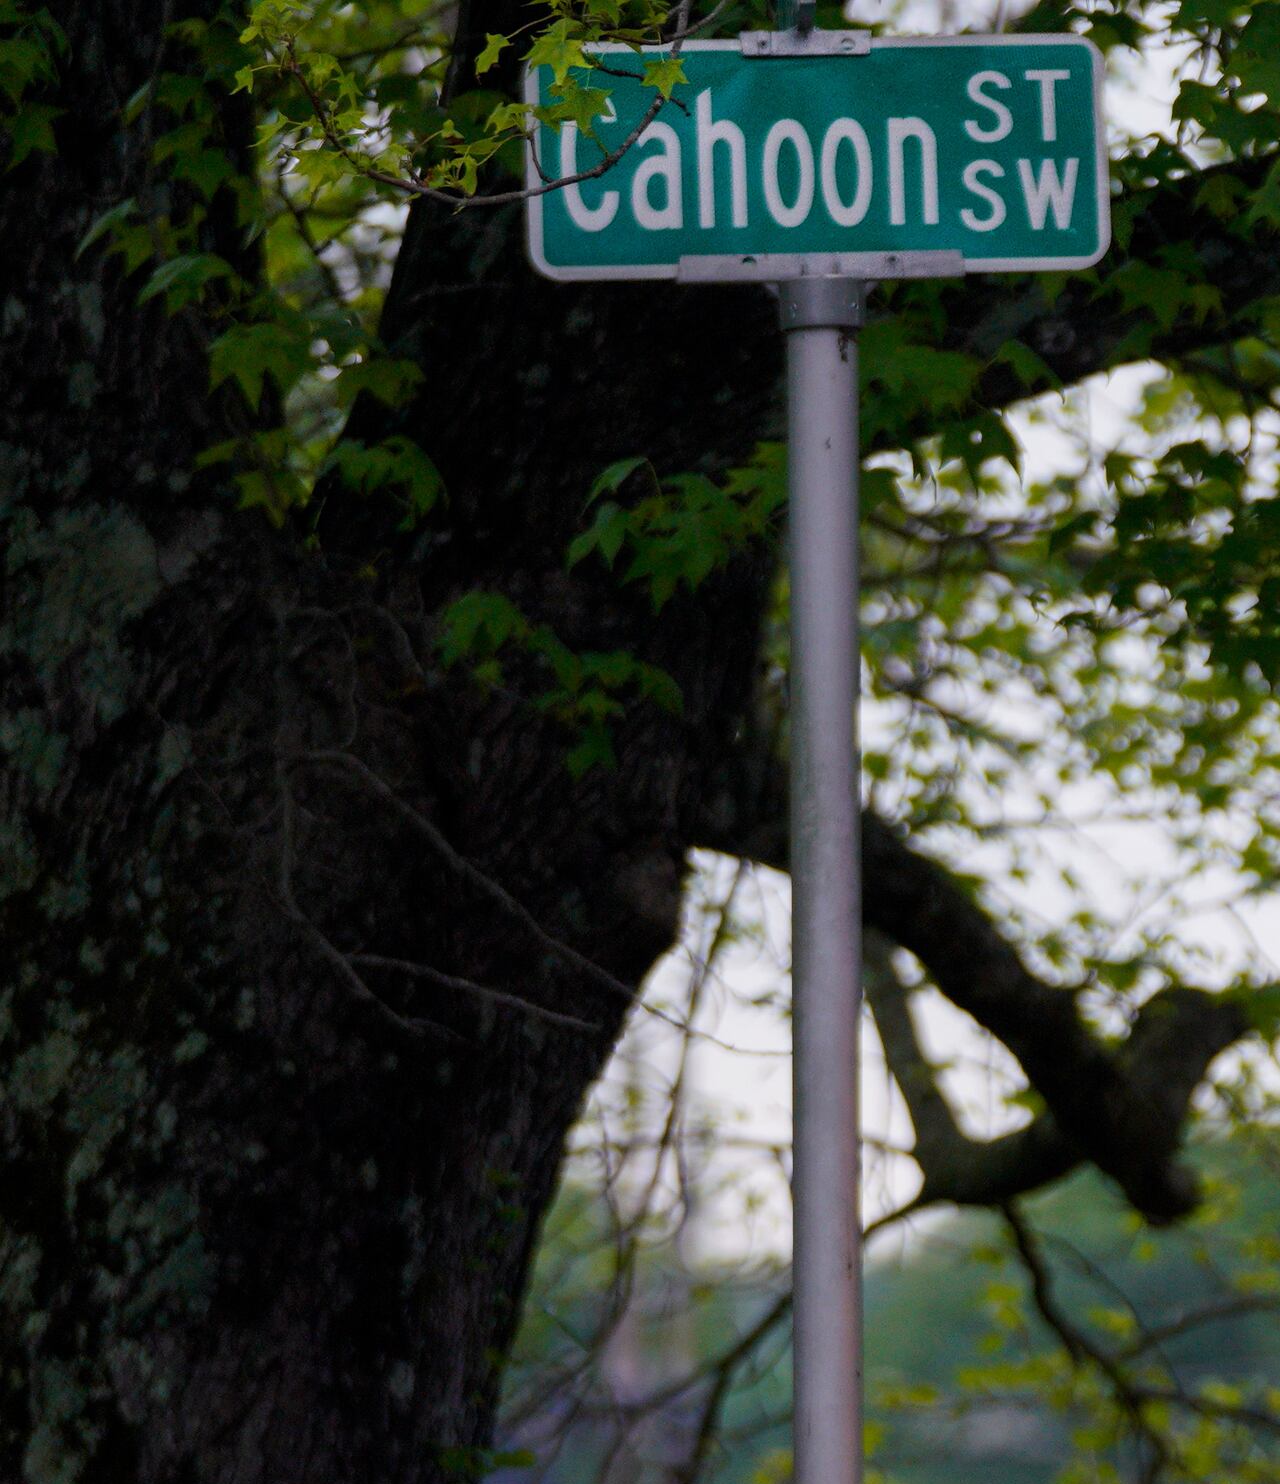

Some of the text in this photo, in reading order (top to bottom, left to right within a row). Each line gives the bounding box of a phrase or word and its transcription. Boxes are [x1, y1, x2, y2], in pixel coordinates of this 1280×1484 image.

[963, 68, 1071, 143] ST
[560, 88, 940, 233] Cahoon
[960, 158, 1080, 232] SW
